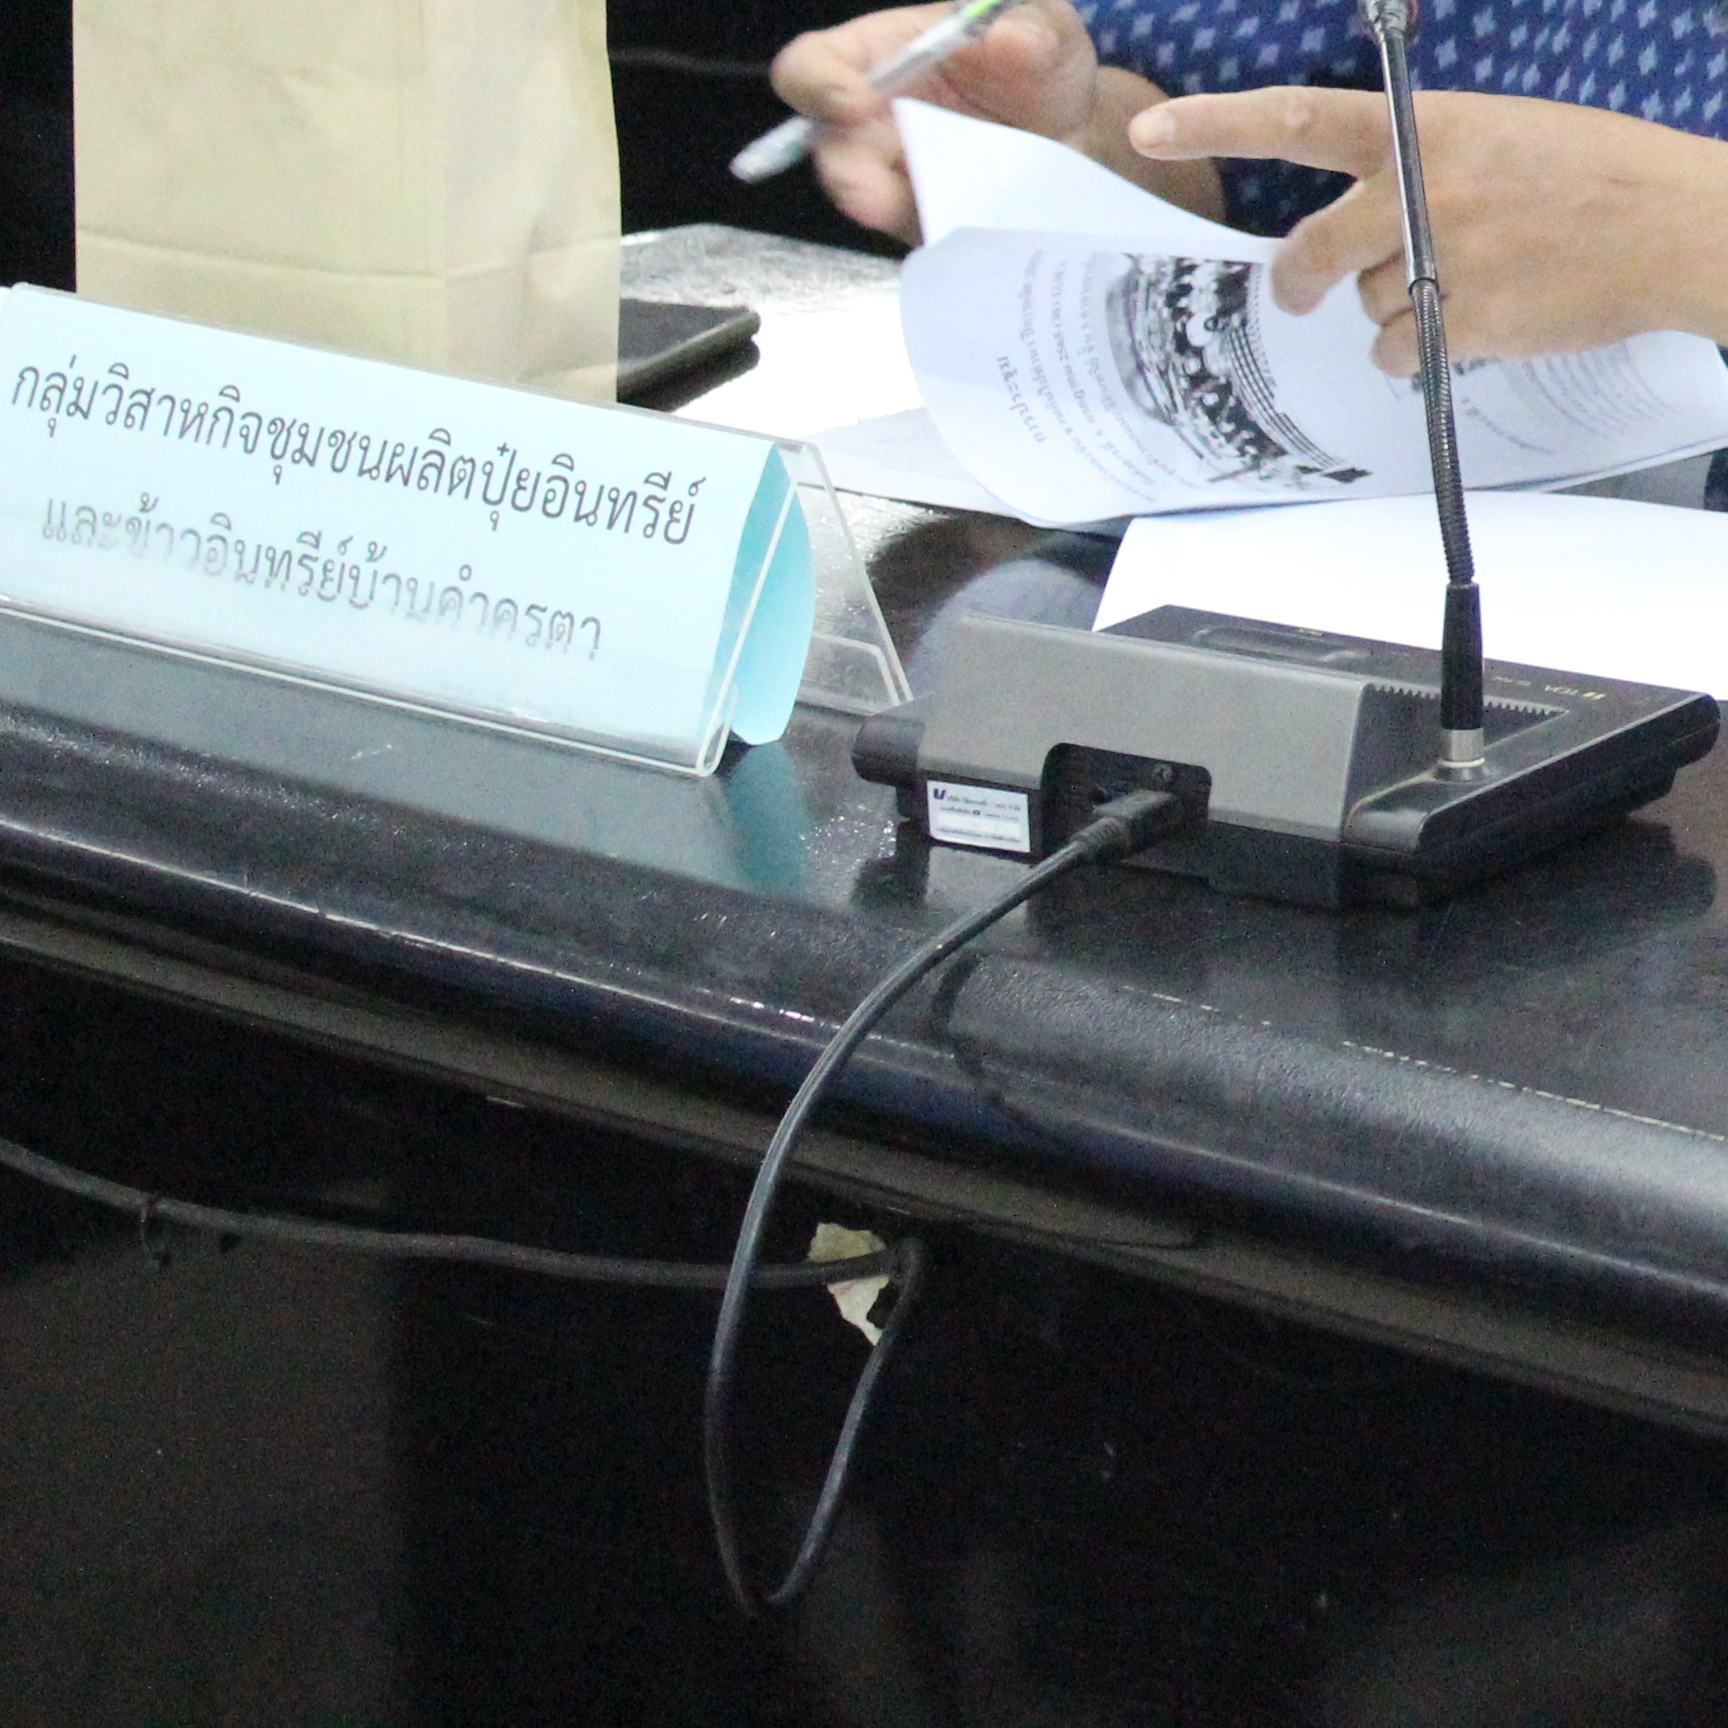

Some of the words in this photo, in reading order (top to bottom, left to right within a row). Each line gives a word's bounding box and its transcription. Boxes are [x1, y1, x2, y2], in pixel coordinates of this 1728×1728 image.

[11, 354, 707, 546] กลุ่มวิสาหกิจชุมชนผลิตปุ๋ยอินทรีย์
